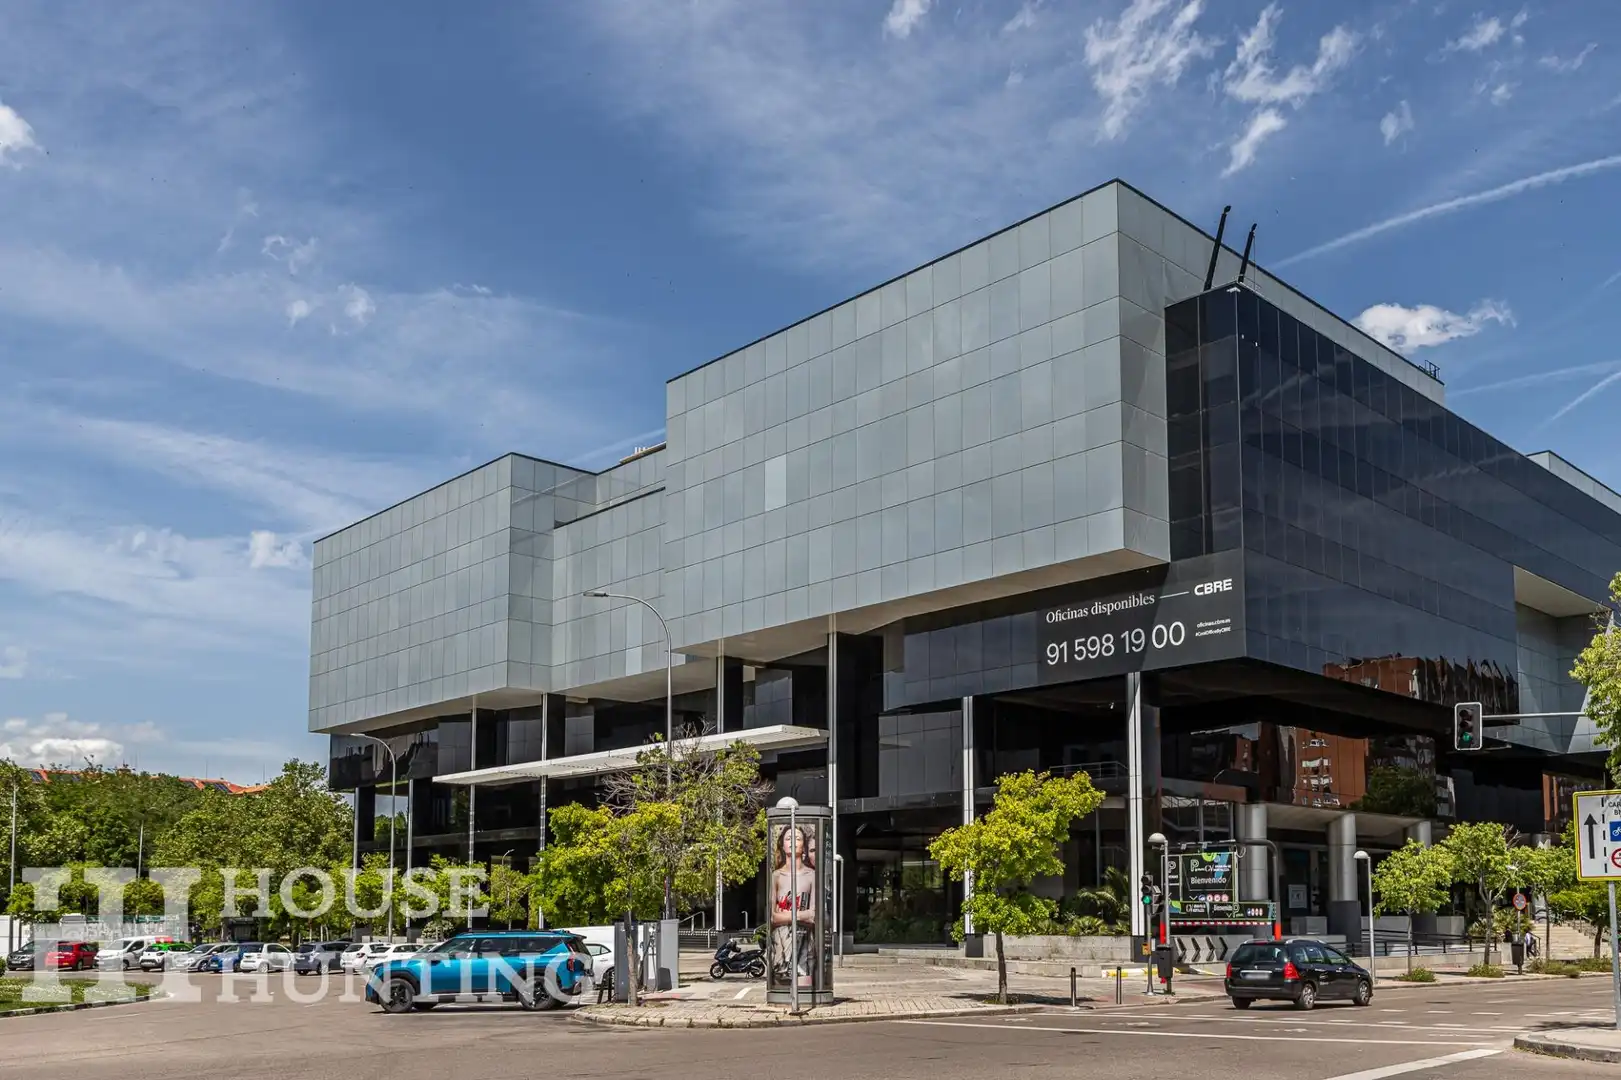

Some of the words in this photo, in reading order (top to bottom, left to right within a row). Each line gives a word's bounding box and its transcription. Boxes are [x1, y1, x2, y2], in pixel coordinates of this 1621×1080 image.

[1194, 578, 1233, 596] CBRE
[1046, 606, 1088, 623] Oficinas
[1091, 593, 1155, 615] disponibles
[1046, 641, 1068, 665] 91
[1073, 633, 1115, 661] 598
[1120, 628, 1145, 654] 19
[1151, 621, 1185, 649] 00
